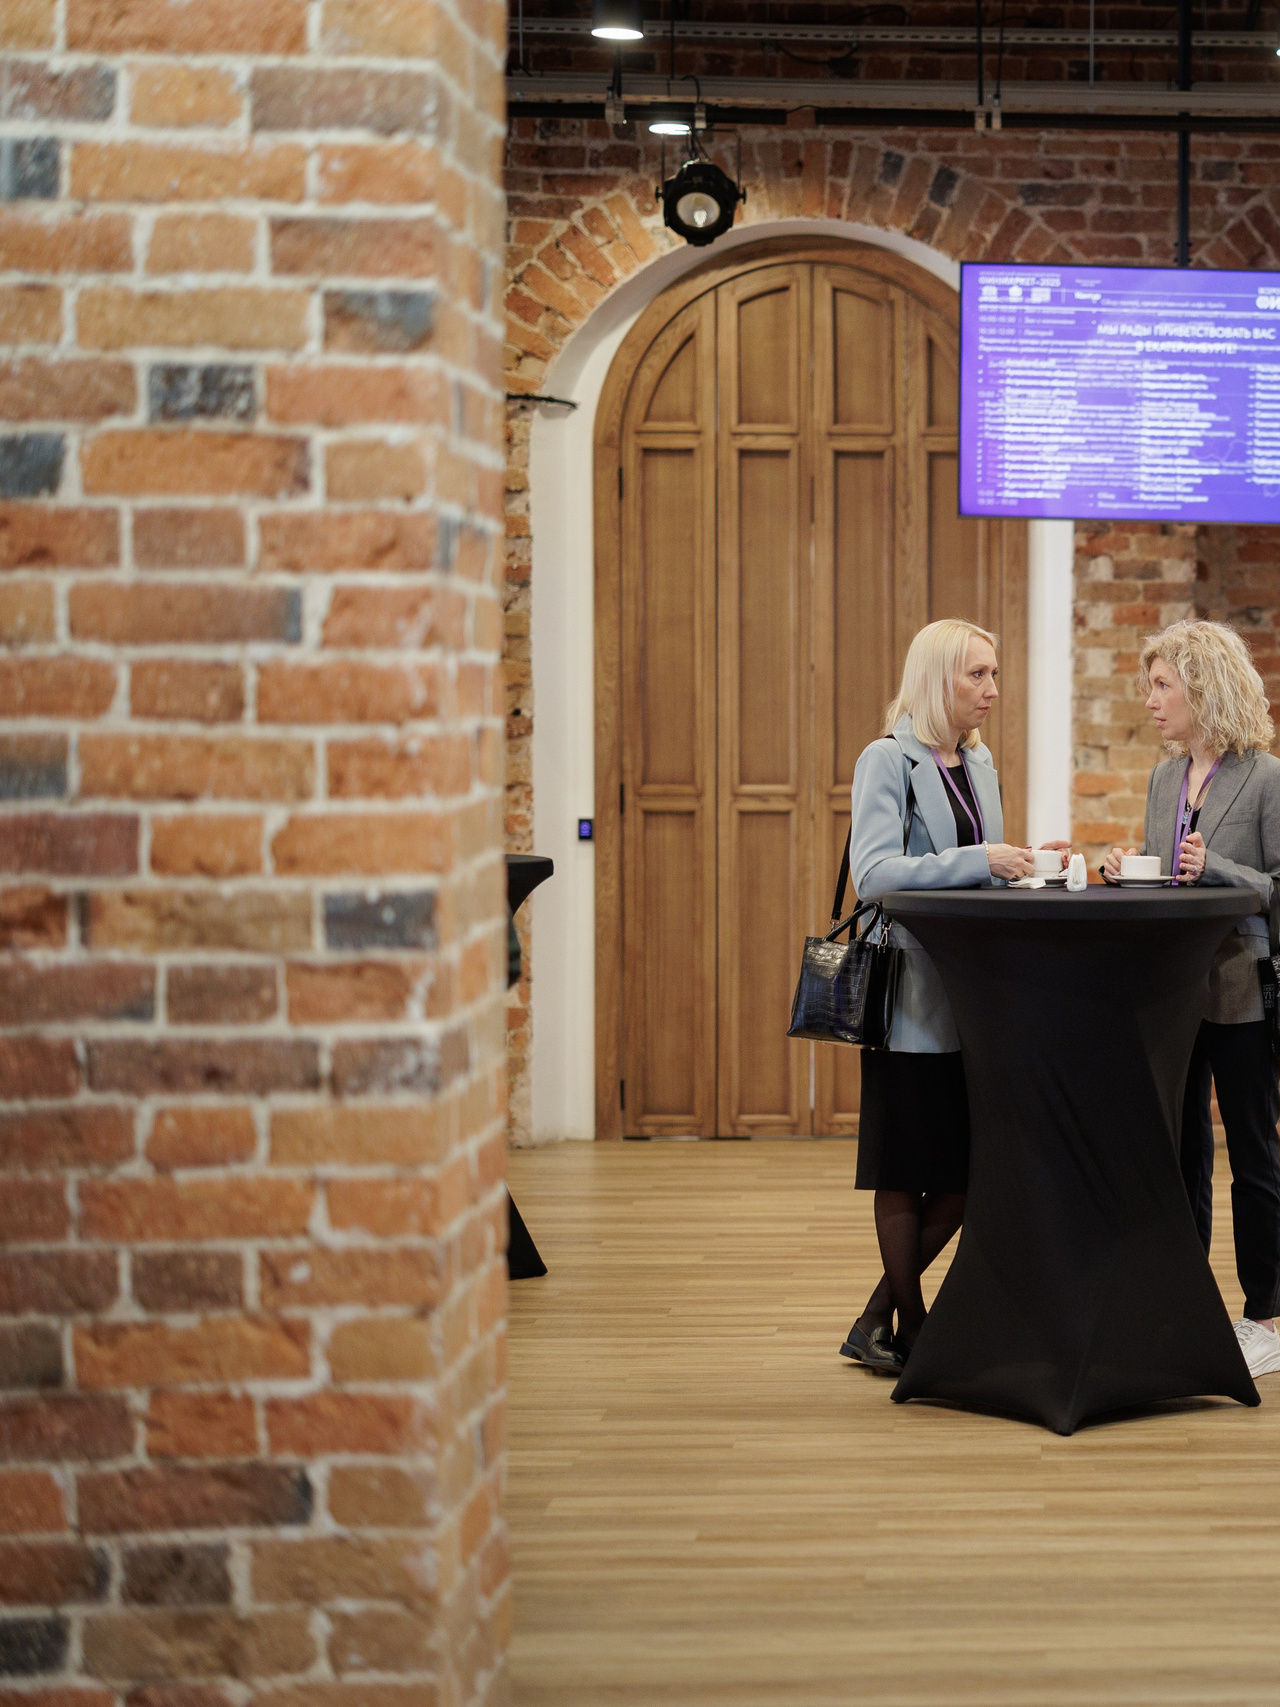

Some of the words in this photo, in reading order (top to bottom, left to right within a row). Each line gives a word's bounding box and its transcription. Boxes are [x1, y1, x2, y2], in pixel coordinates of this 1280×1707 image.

[1097, 324, 1118, 335] МЫ
[1120, 324, 1151, 336] РАДЫ
[1253, 328, 1276, 340] ВАС
